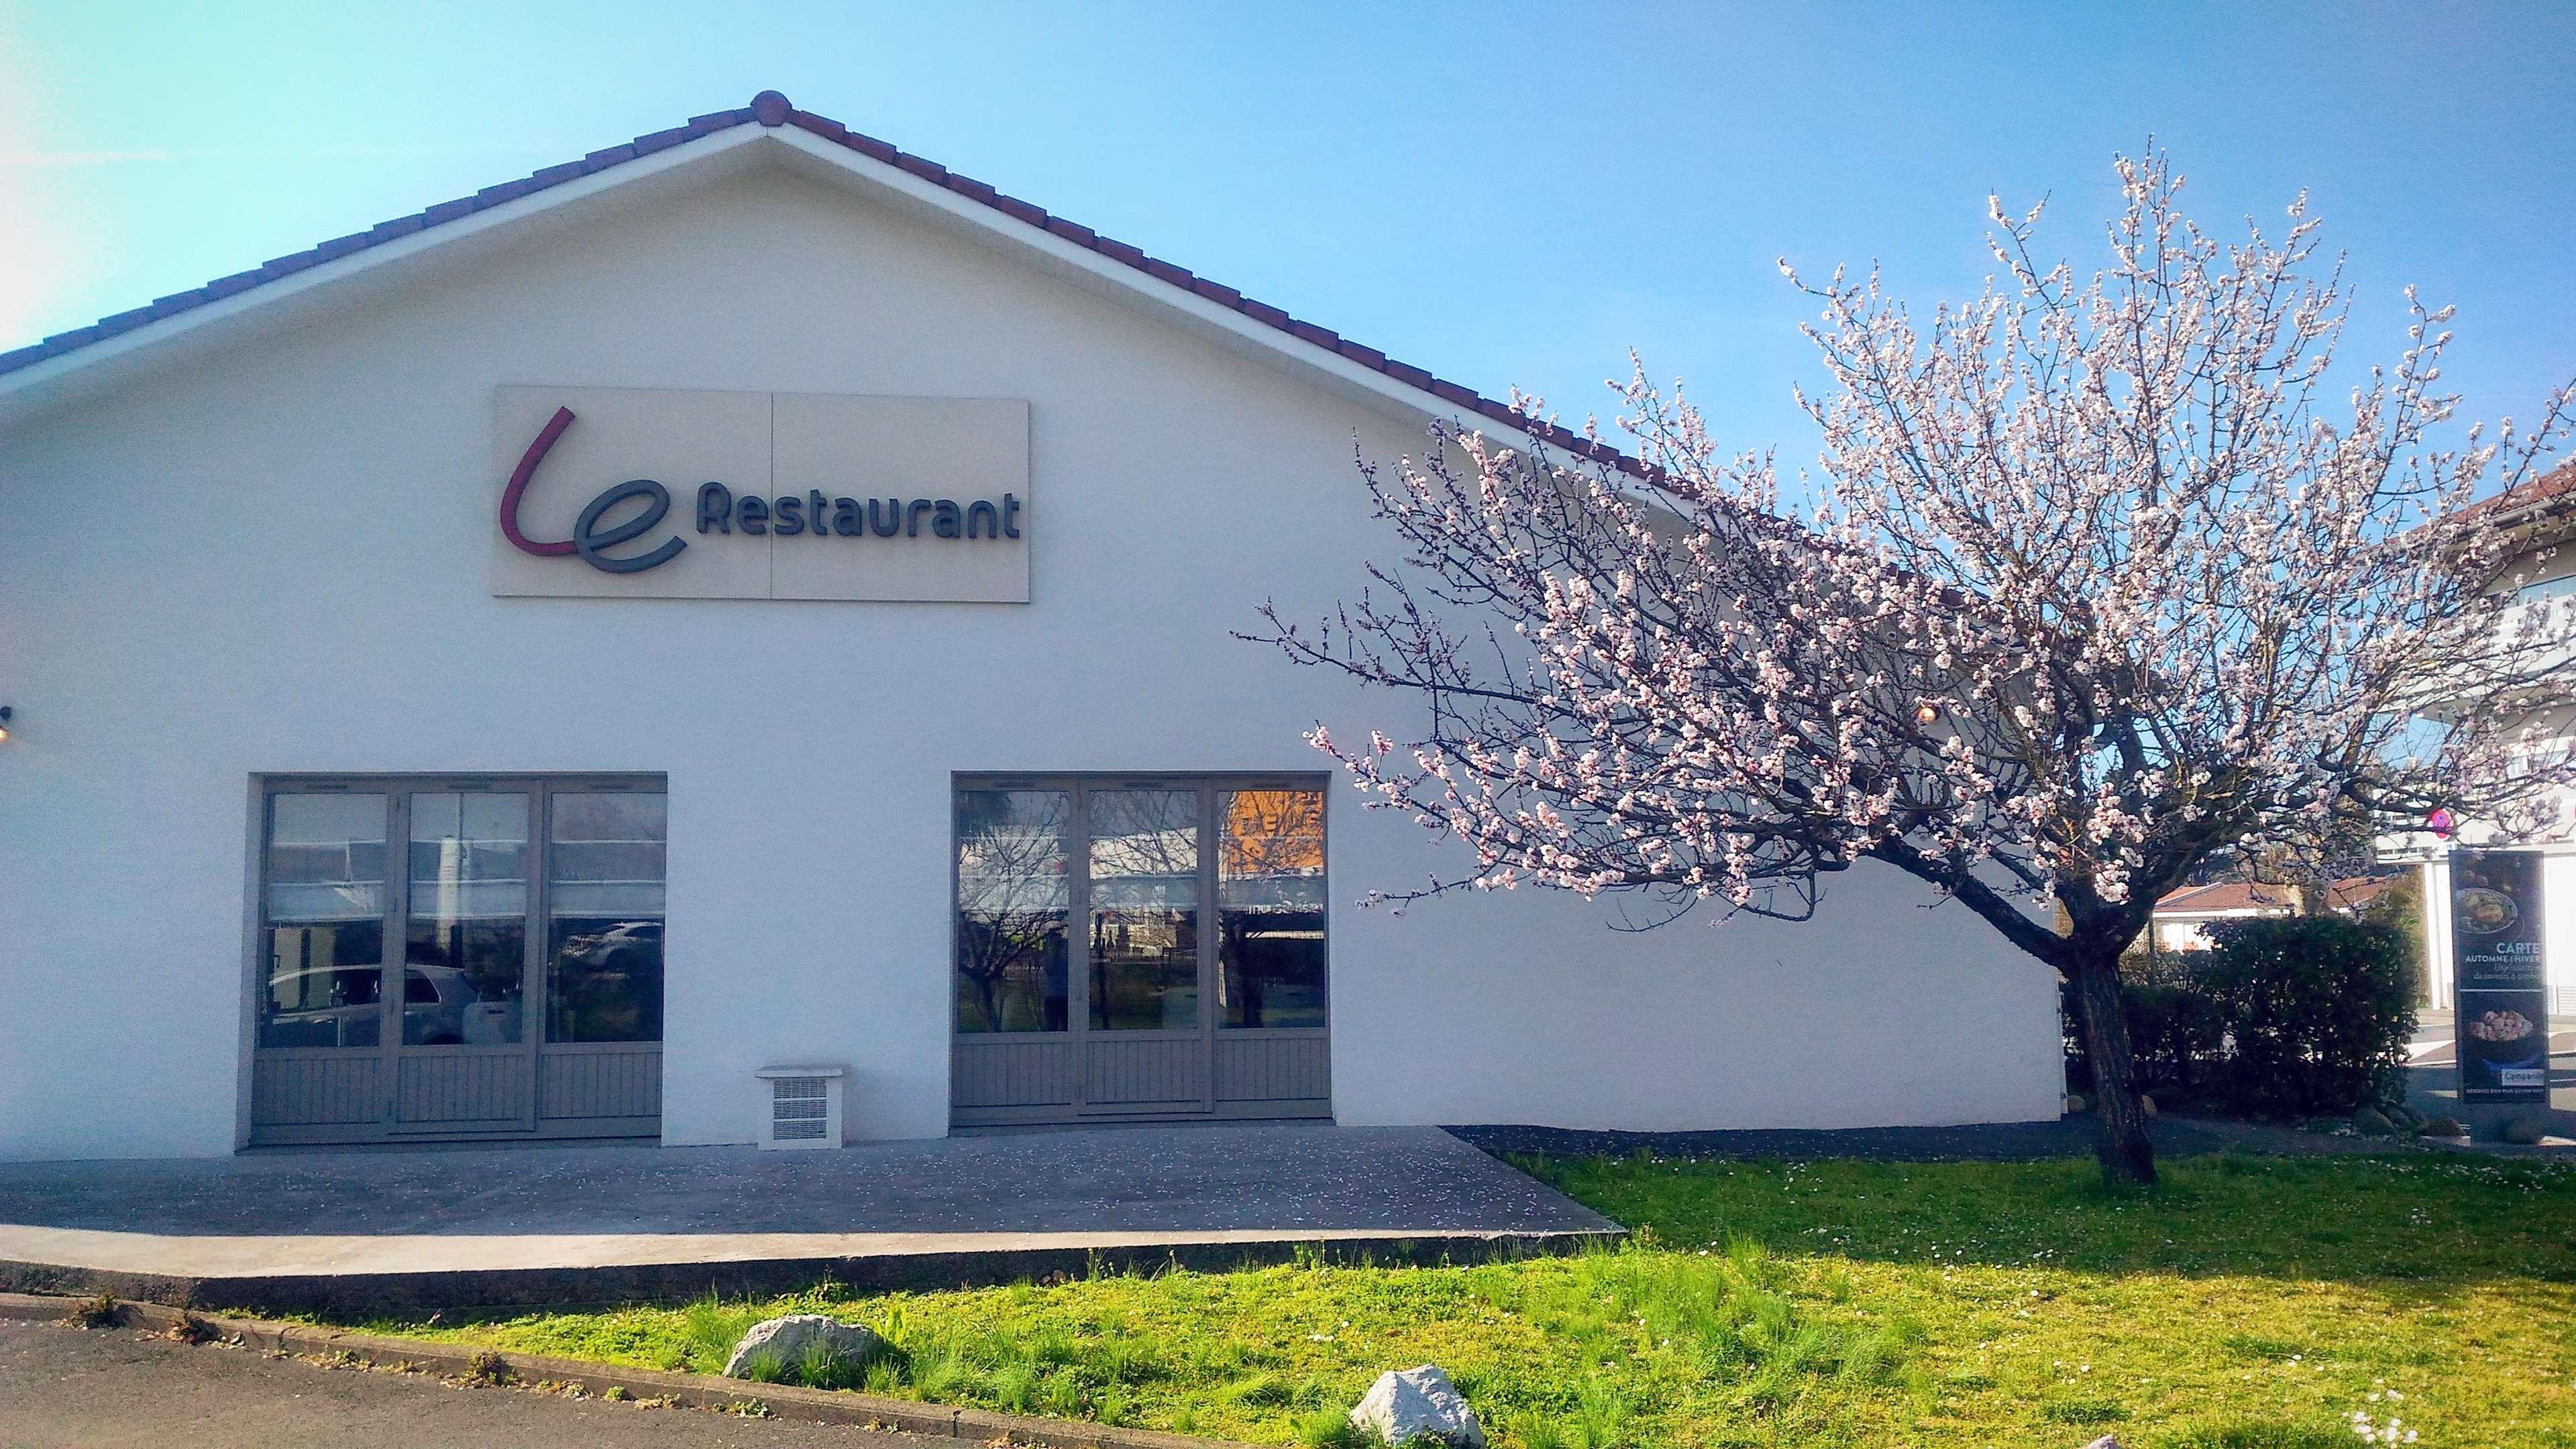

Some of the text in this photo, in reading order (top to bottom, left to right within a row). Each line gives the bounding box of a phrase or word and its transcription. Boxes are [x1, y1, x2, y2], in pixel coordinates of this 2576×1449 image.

[500, 405, 1020, 574] Le Restaurant
[2496, 942, 2540, 954] CARTE
[2465, 955, 2508, 963] AUTOMNE
